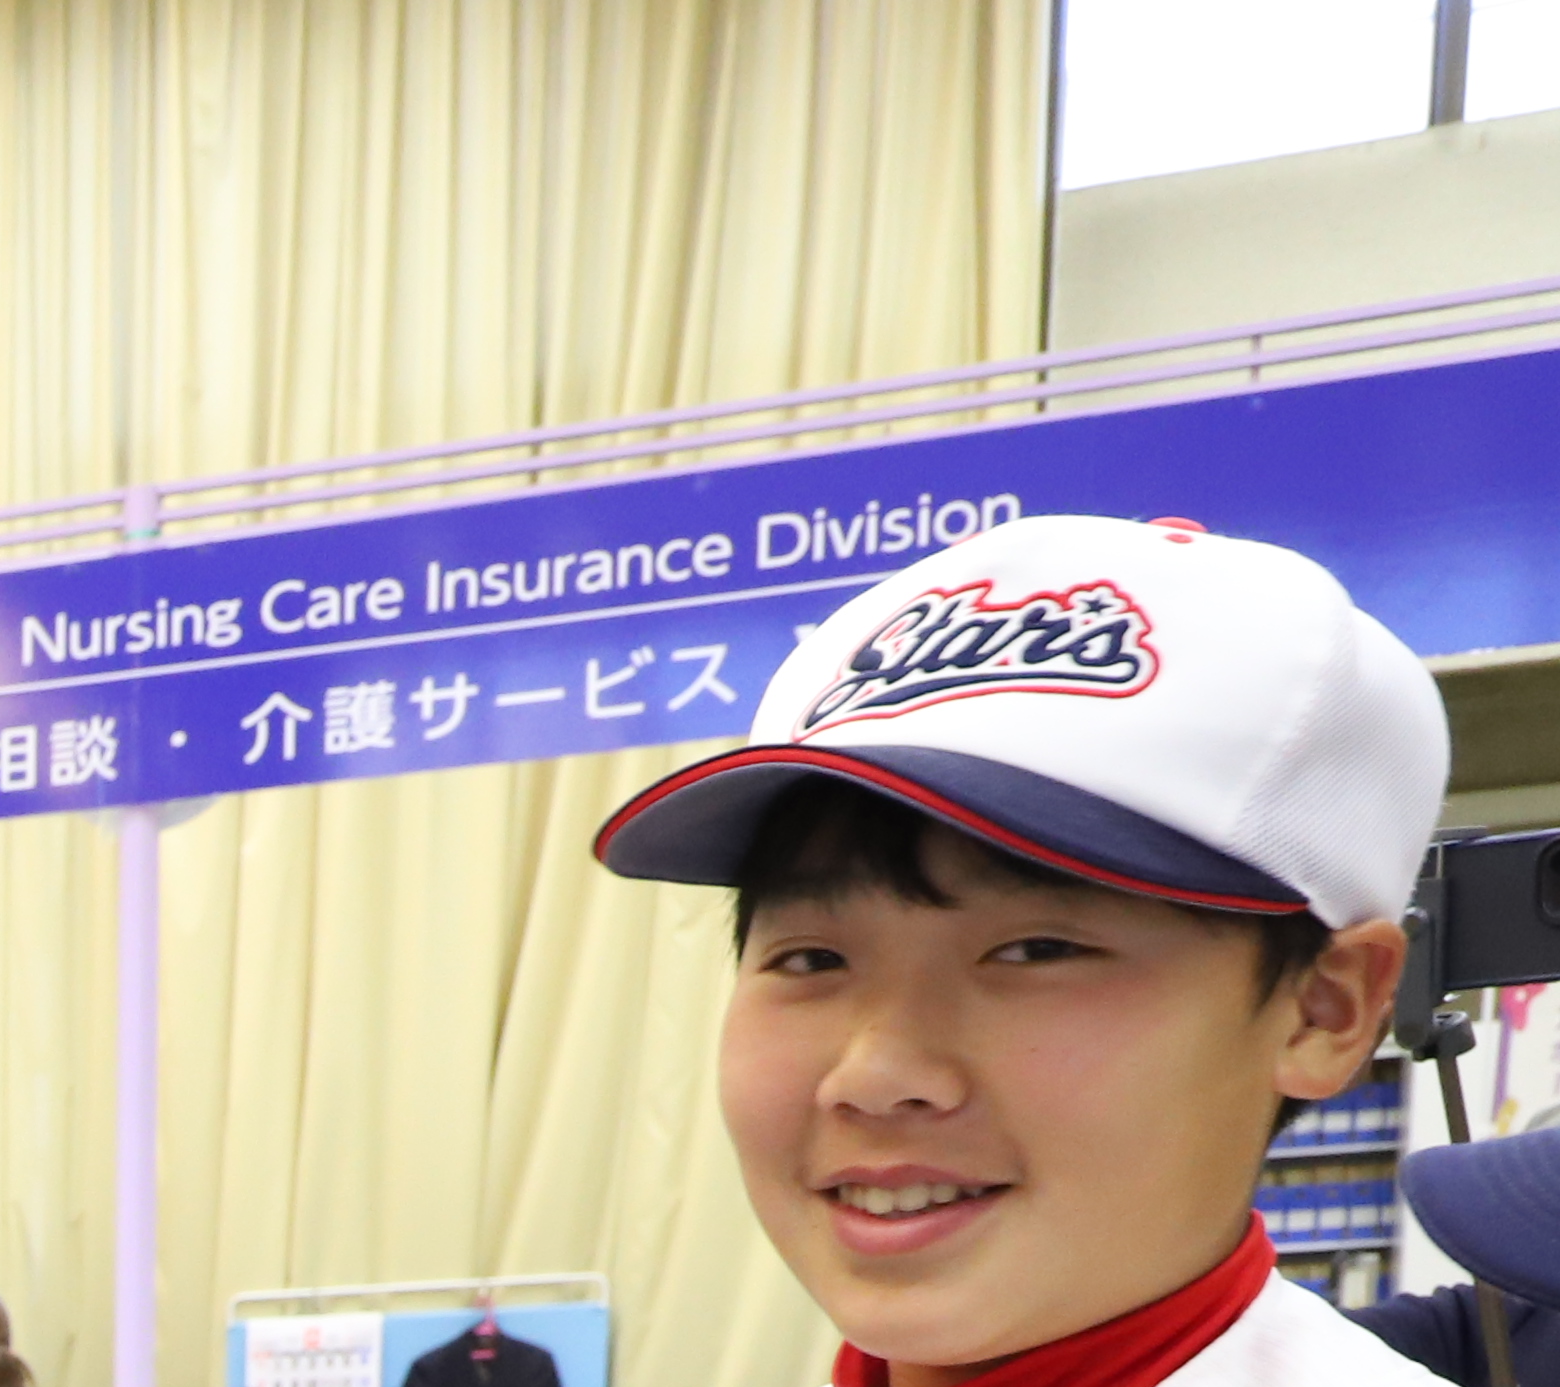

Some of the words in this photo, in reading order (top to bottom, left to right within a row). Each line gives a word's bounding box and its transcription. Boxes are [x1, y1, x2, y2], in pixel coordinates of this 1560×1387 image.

[20, 579, 242, 664] Nursing
[257, 569, 405, 638] Care
[422, 520, 734, 619] Insurance
[756, 493, 1023, 571] Division
